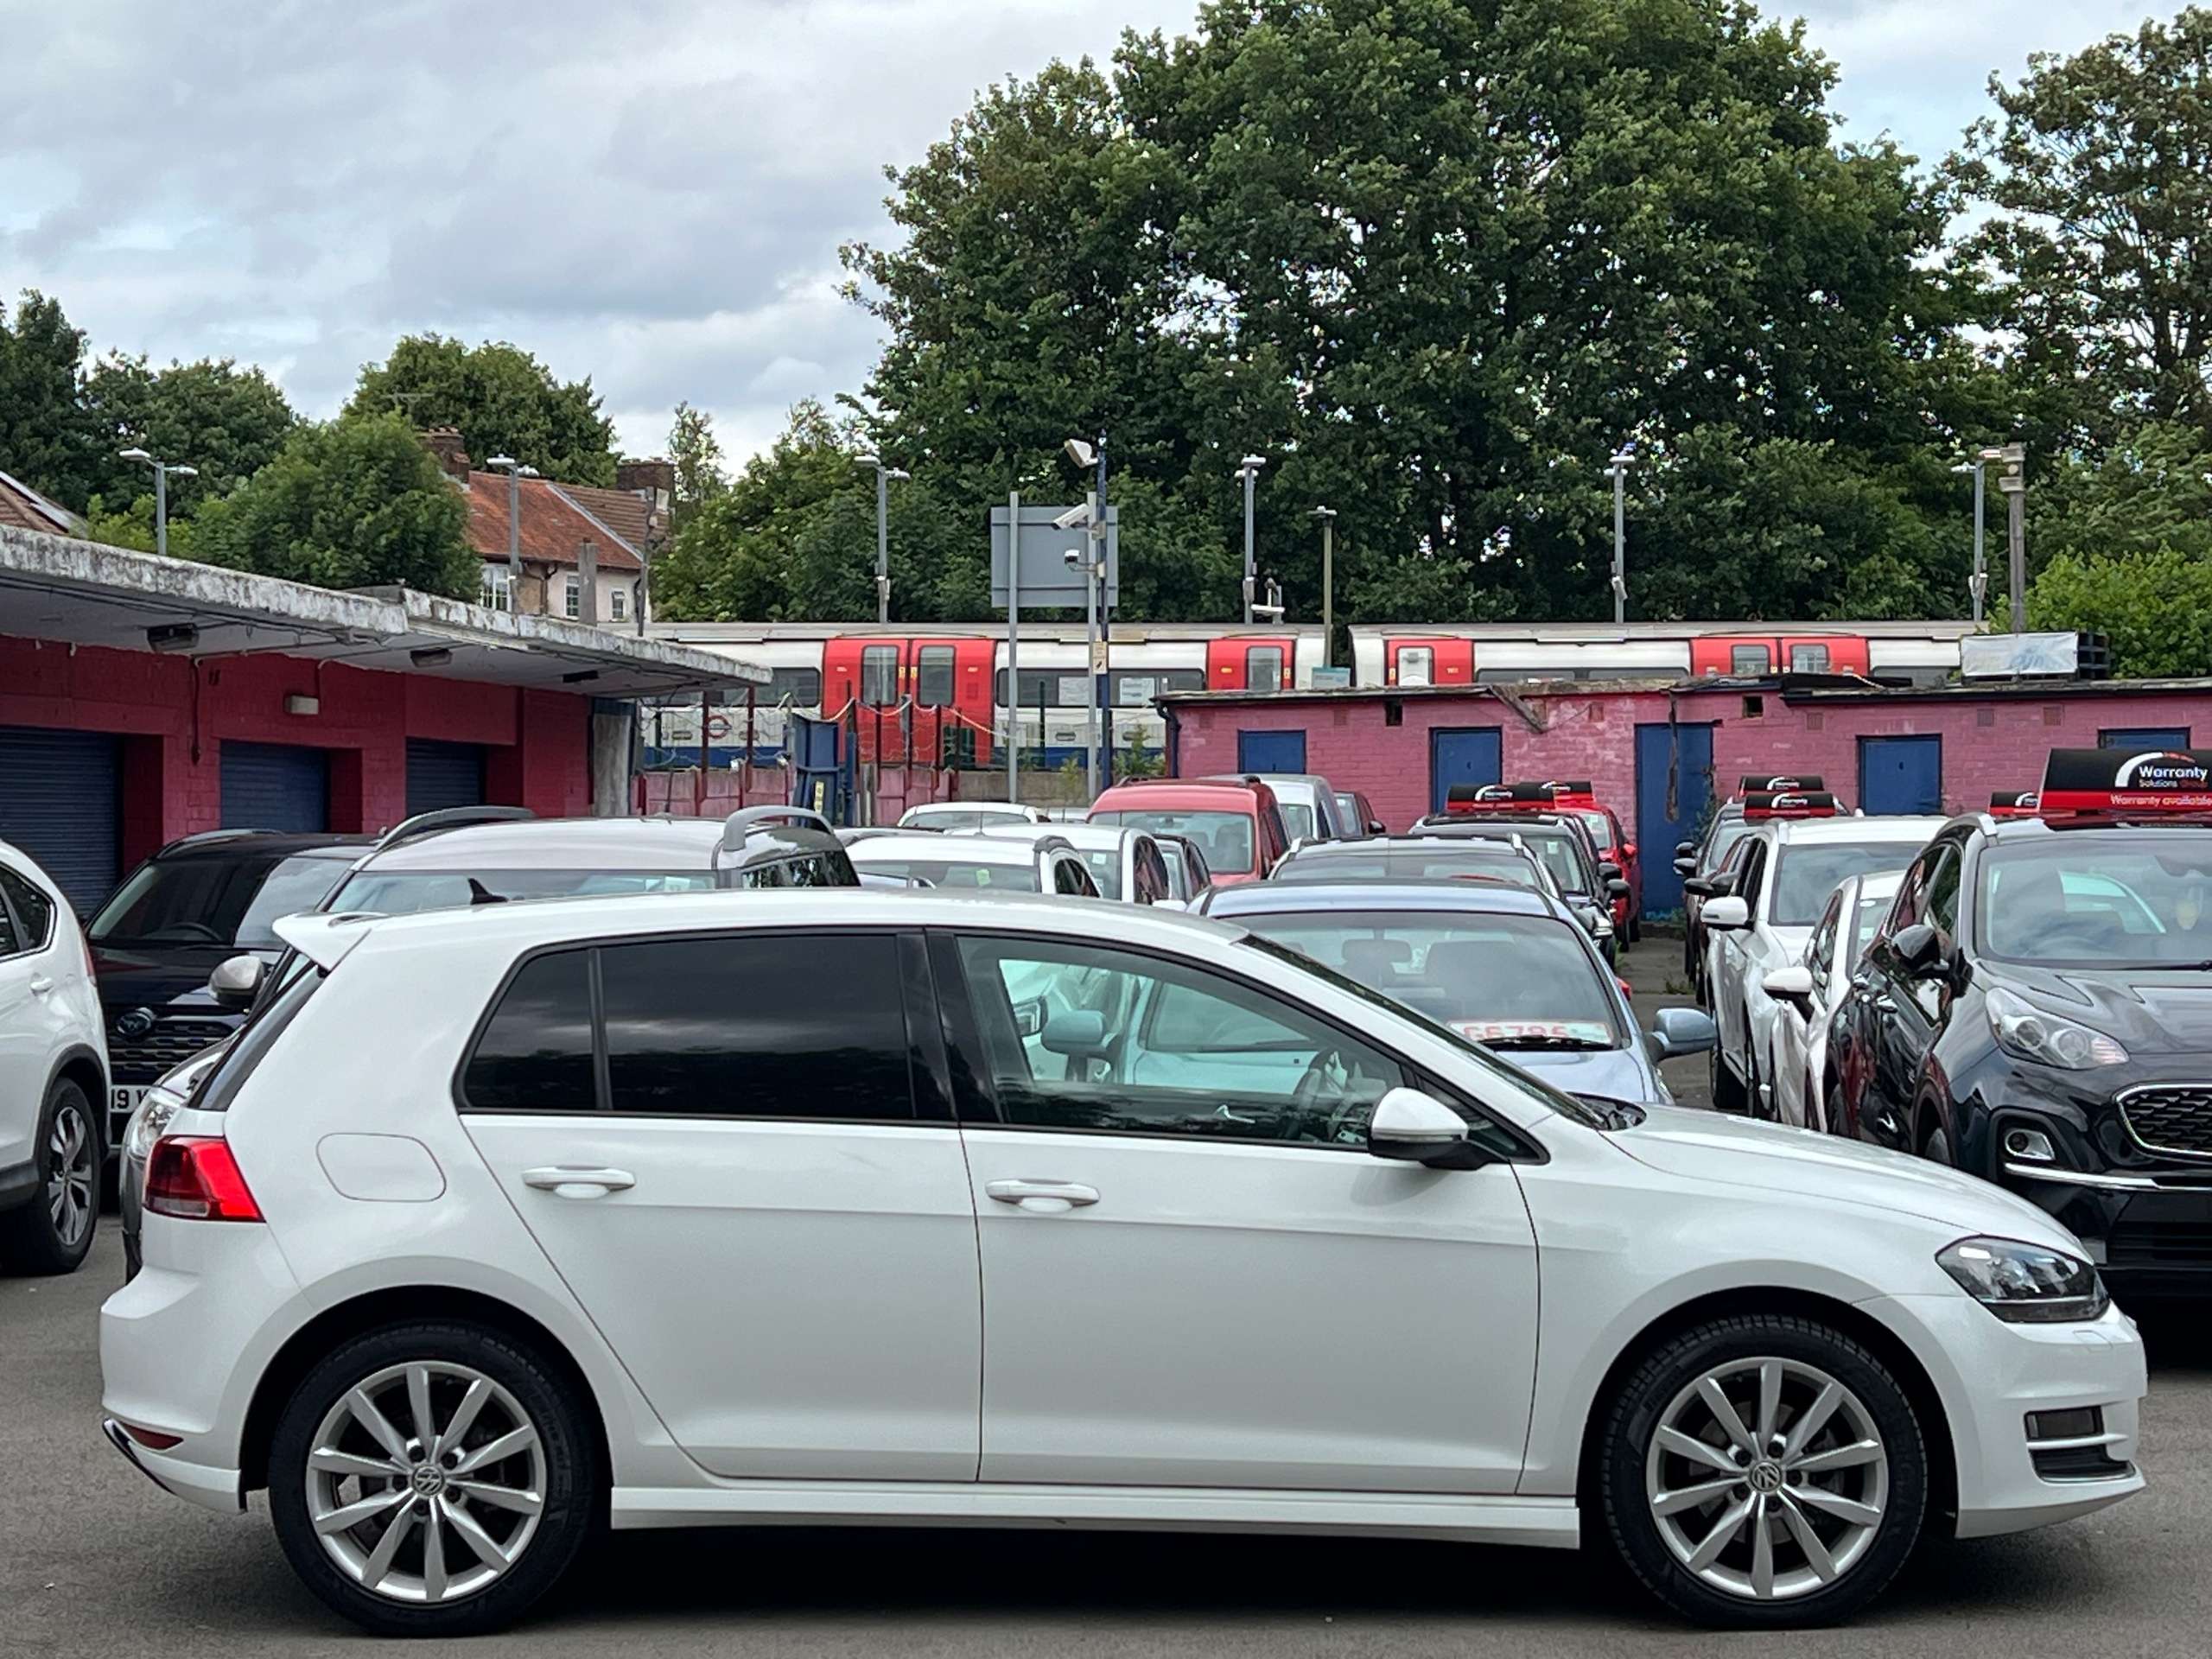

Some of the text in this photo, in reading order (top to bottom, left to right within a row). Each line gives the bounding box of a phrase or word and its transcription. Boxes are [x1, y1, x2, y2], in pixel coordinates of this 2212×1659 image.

[2139, 766, 2208, 781] Warranty
[2139, 779, 2178, 788] Solutions
[2110, 795, 2161, 807] Warranty
